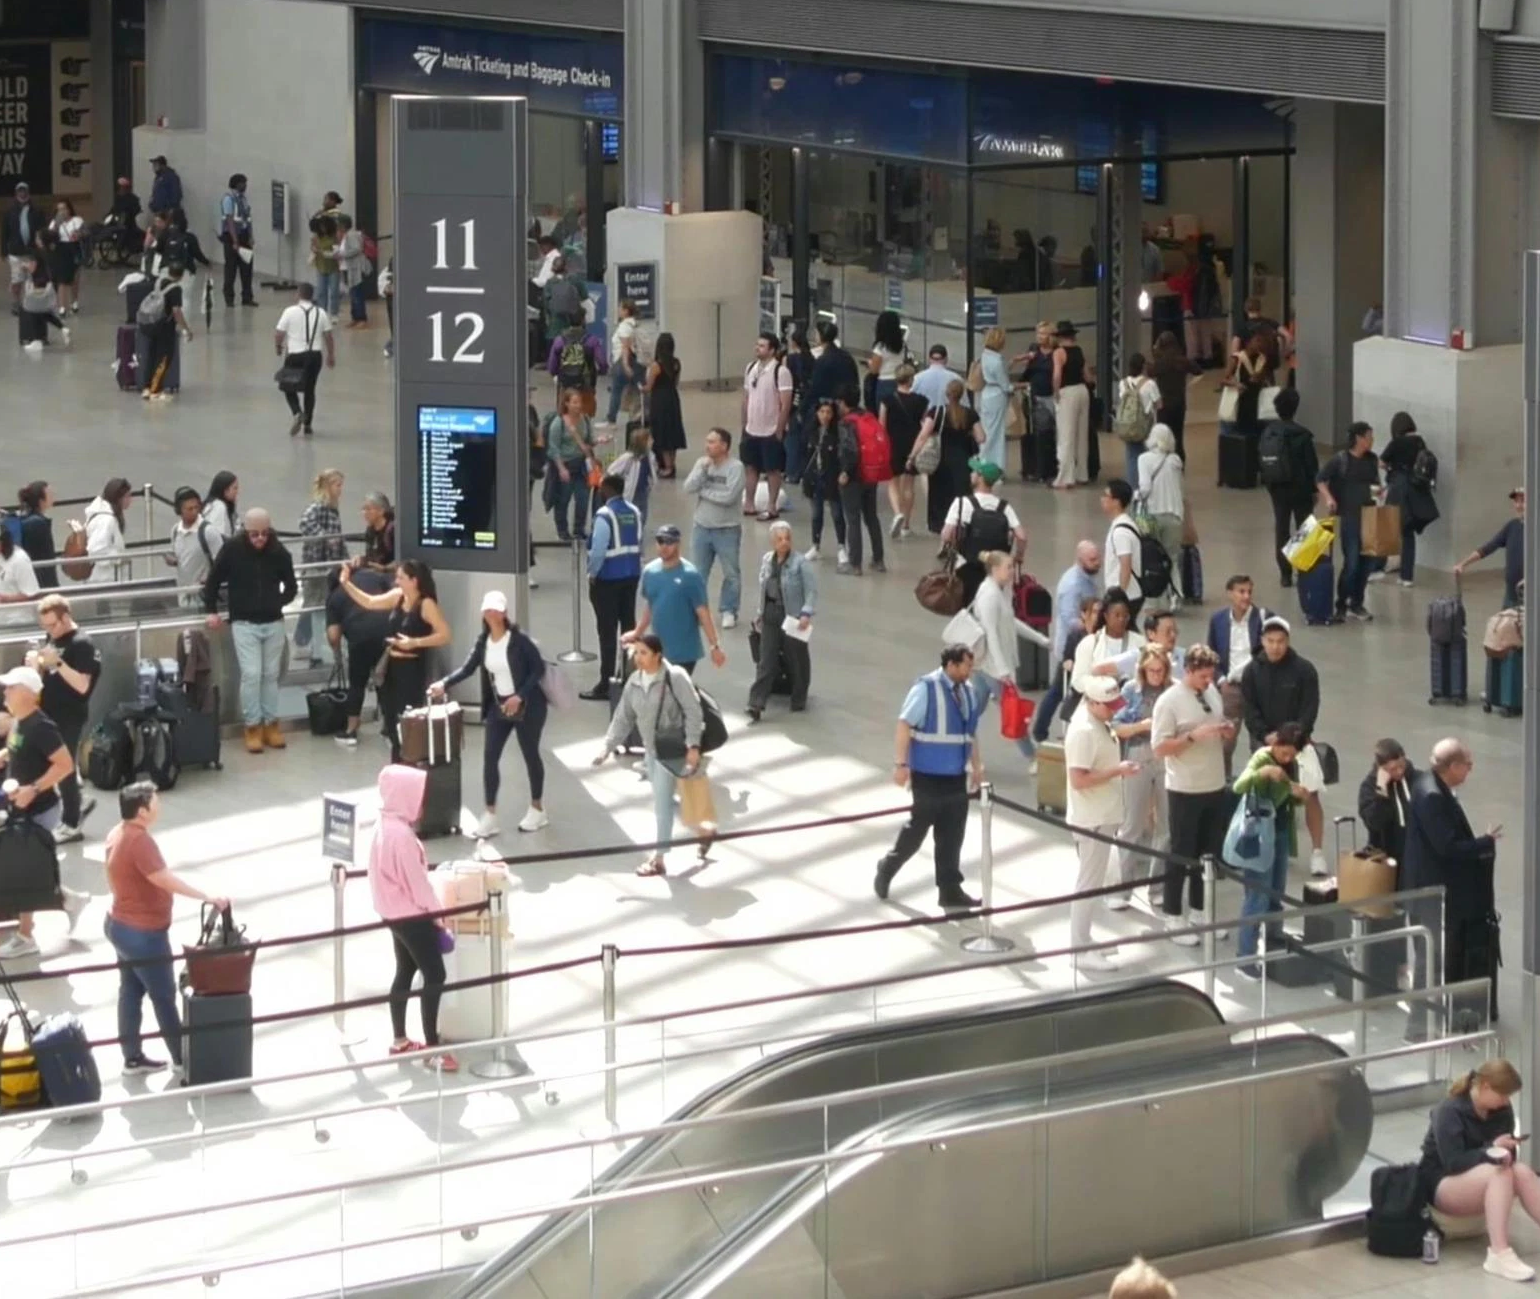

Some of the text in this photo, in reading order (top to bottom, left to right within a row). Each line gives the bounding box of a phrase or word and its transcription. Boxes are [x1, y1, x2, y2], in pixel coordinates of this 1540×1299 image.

[442, 52, 611, 88] Amtrak Ticketing and Baggage Check-in
[431, 217, 480, 271] 11
[624, 271, 650, 283] Enter
[427, 310, 485, 364] 12
